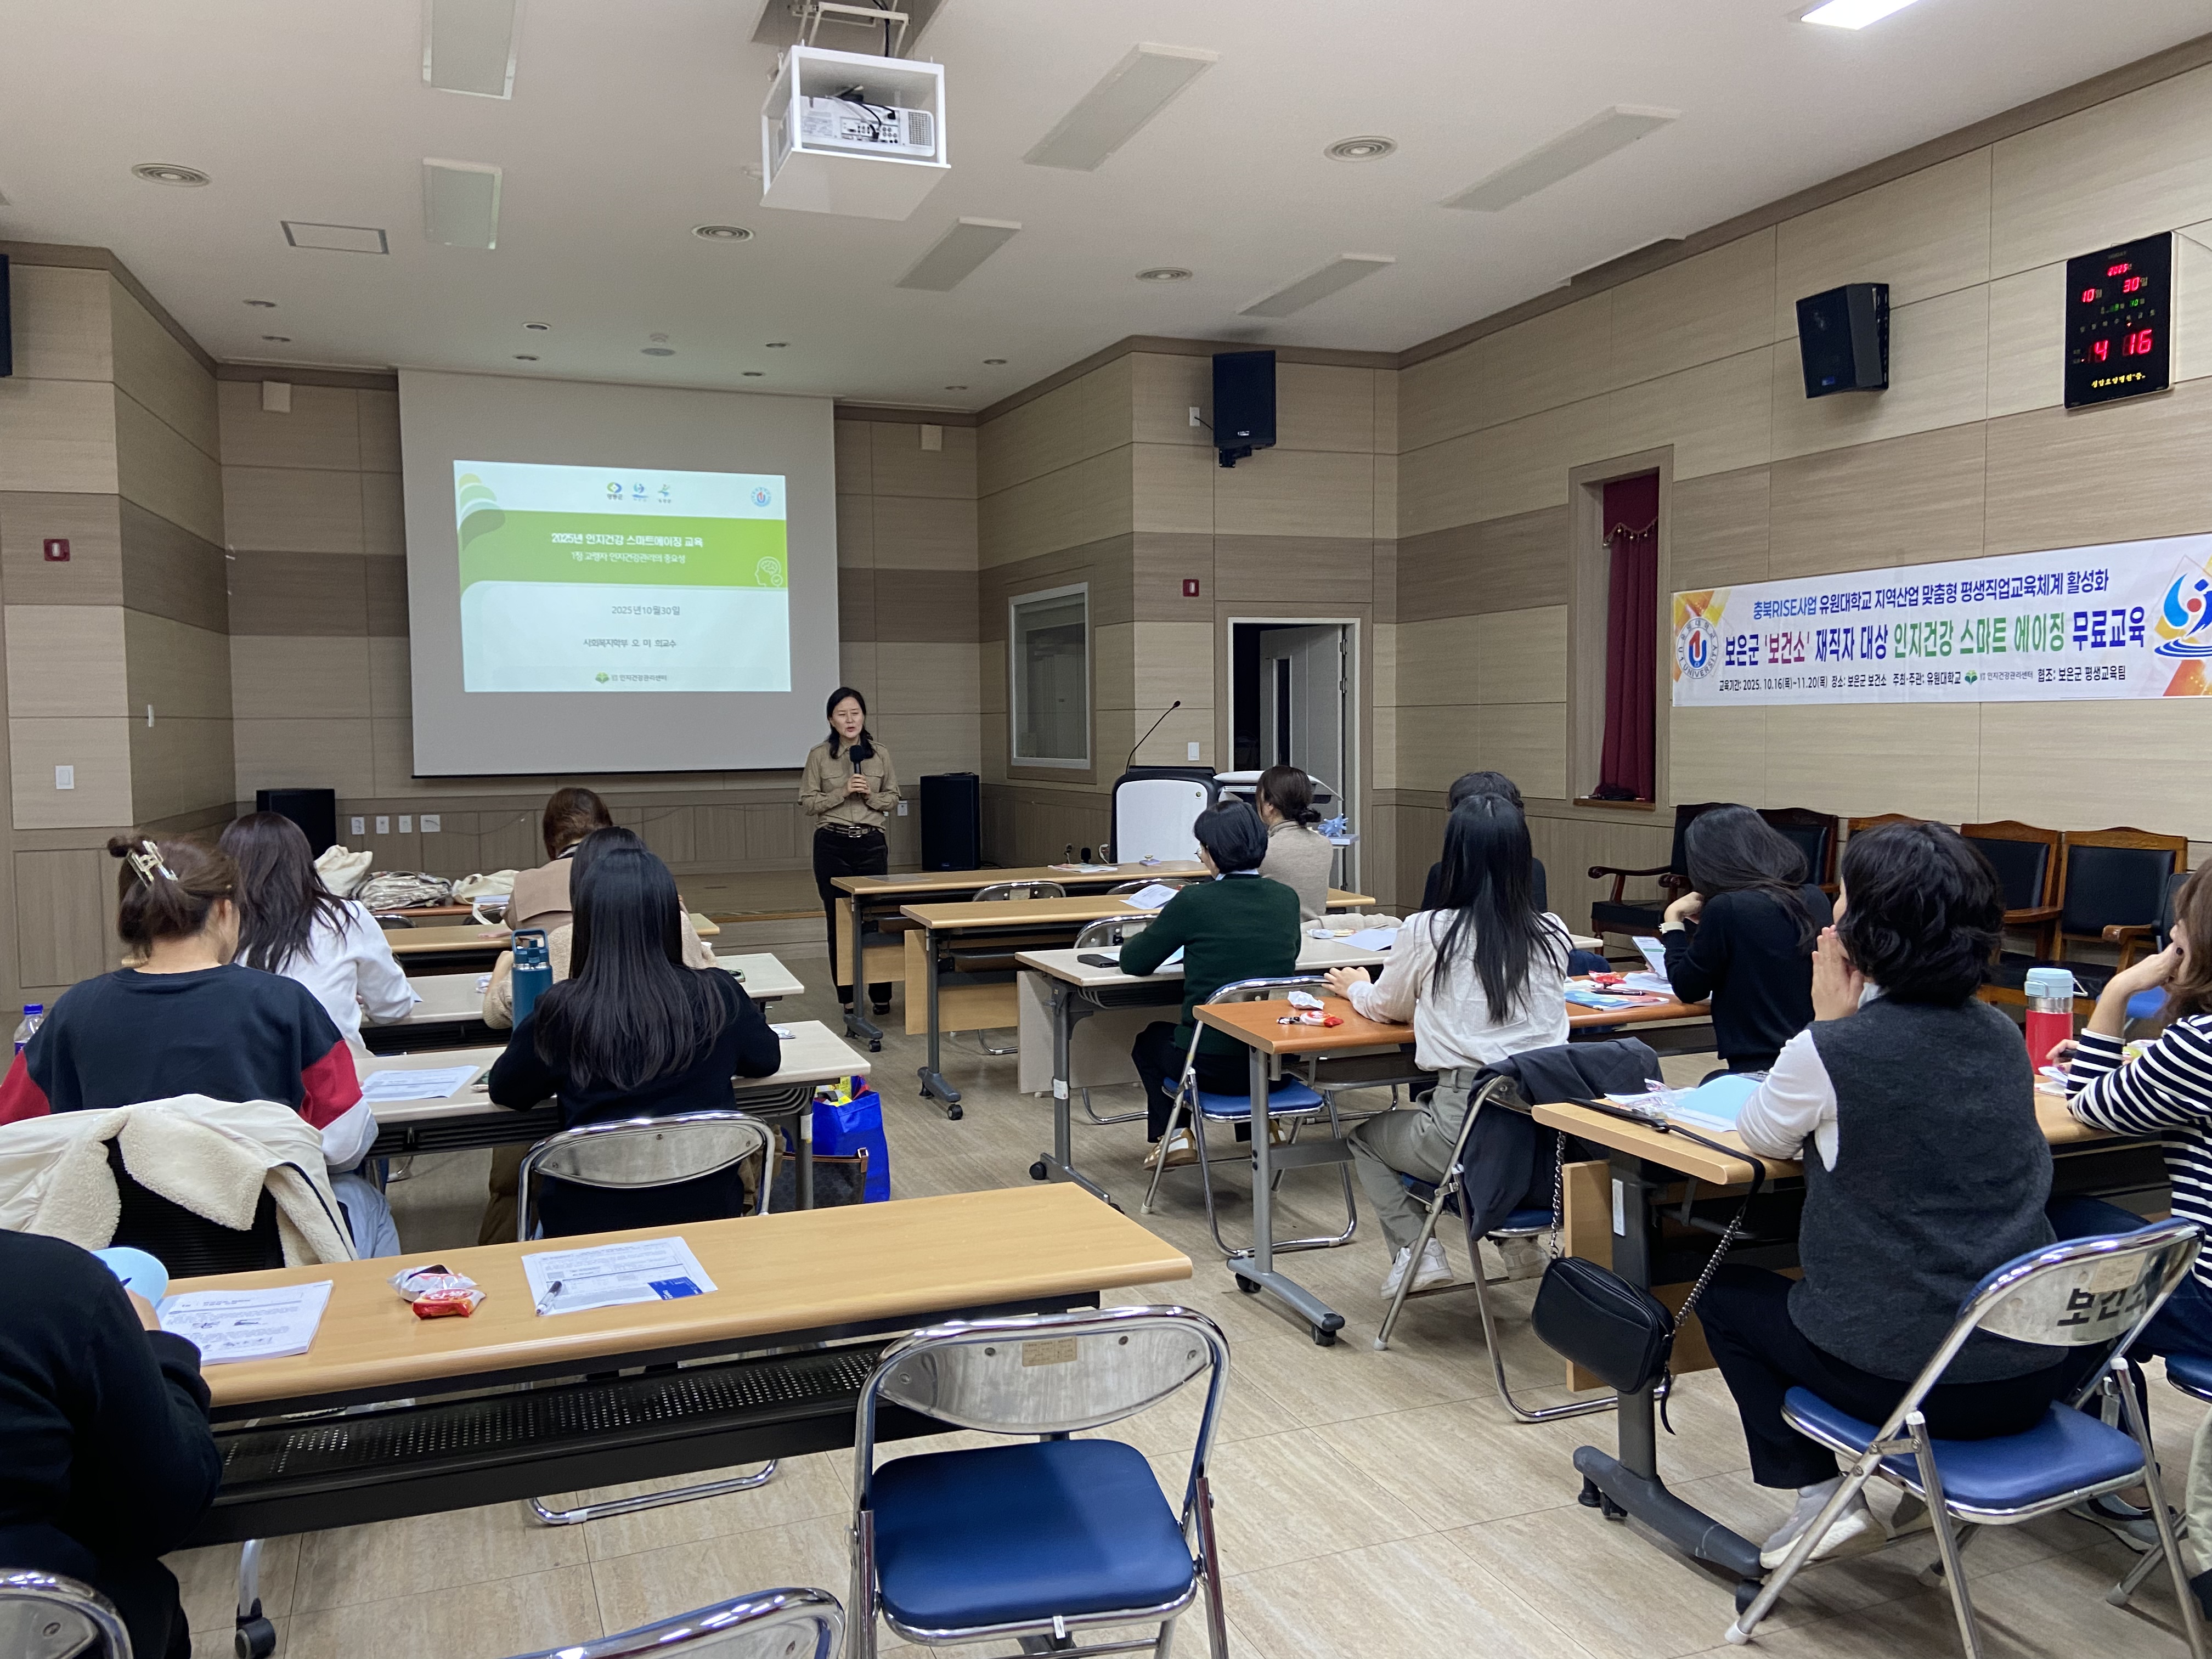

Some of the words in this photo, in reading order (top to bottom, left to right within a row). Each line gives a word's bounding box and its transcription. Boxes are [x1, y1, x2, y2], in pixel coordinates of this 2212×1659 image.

[2108, 263, 2129, 276] 2025
[2123, 276, 2140, 293] 30
[2082, 289, 2095, 302] 10
[2094, 340, 2108, 361] 4
[2130, 329, 2152, 355] 16
[551, 533, 583, 544] 2025년
[586, 534, 624, 545] 인지건강
[627, 535, 682, 547] 스마트에이징
[685, 537, 703, 548] 교육
[1753, 596, 1817, 619] 충북RISE사업
[1819, 591, 1872, 614] 유원대학교
[1875, 586, 1919, 609] 지역산업
[1922, 582, 1957, 605] 맞춤형
[1961, 572, 2063, 603] 평생직업교육체계
[2067, 568, 2109, 594] 활성화
[611, 606, 680, 616] 2025년10월30일
[583, 639, 628, 647] 사회복지학부
[1725, 634, 1759, 666] 보은군
[1815, 627, 1855, 662] 재직자
[1860, 624, 1888, 660] 대상
[1894, 619, 1954, 658] 인지건강
[1960, 616, 2007, 654] 스마트
[2014, 612, 2065, 653] 에이징
[2072, 606, 2146, 651] 무료교육
[1719, 679, 1741, 691] 교육기간:
[1831, 675, 1846, 688] 장소:
[1848, 674, 1866, 687] 보은군
[1868, 674, 1887, 686] 보건소
[1927, 671, 1961, 685] 유원대학교
[1987, 670, 2033, 680] 인지건강관리센터
[2038, 668, 2056, 682] 협조:
[2059, 667, 2081, 681] 보은군
[2085, 665, 2126, 681] 평생교육팀
